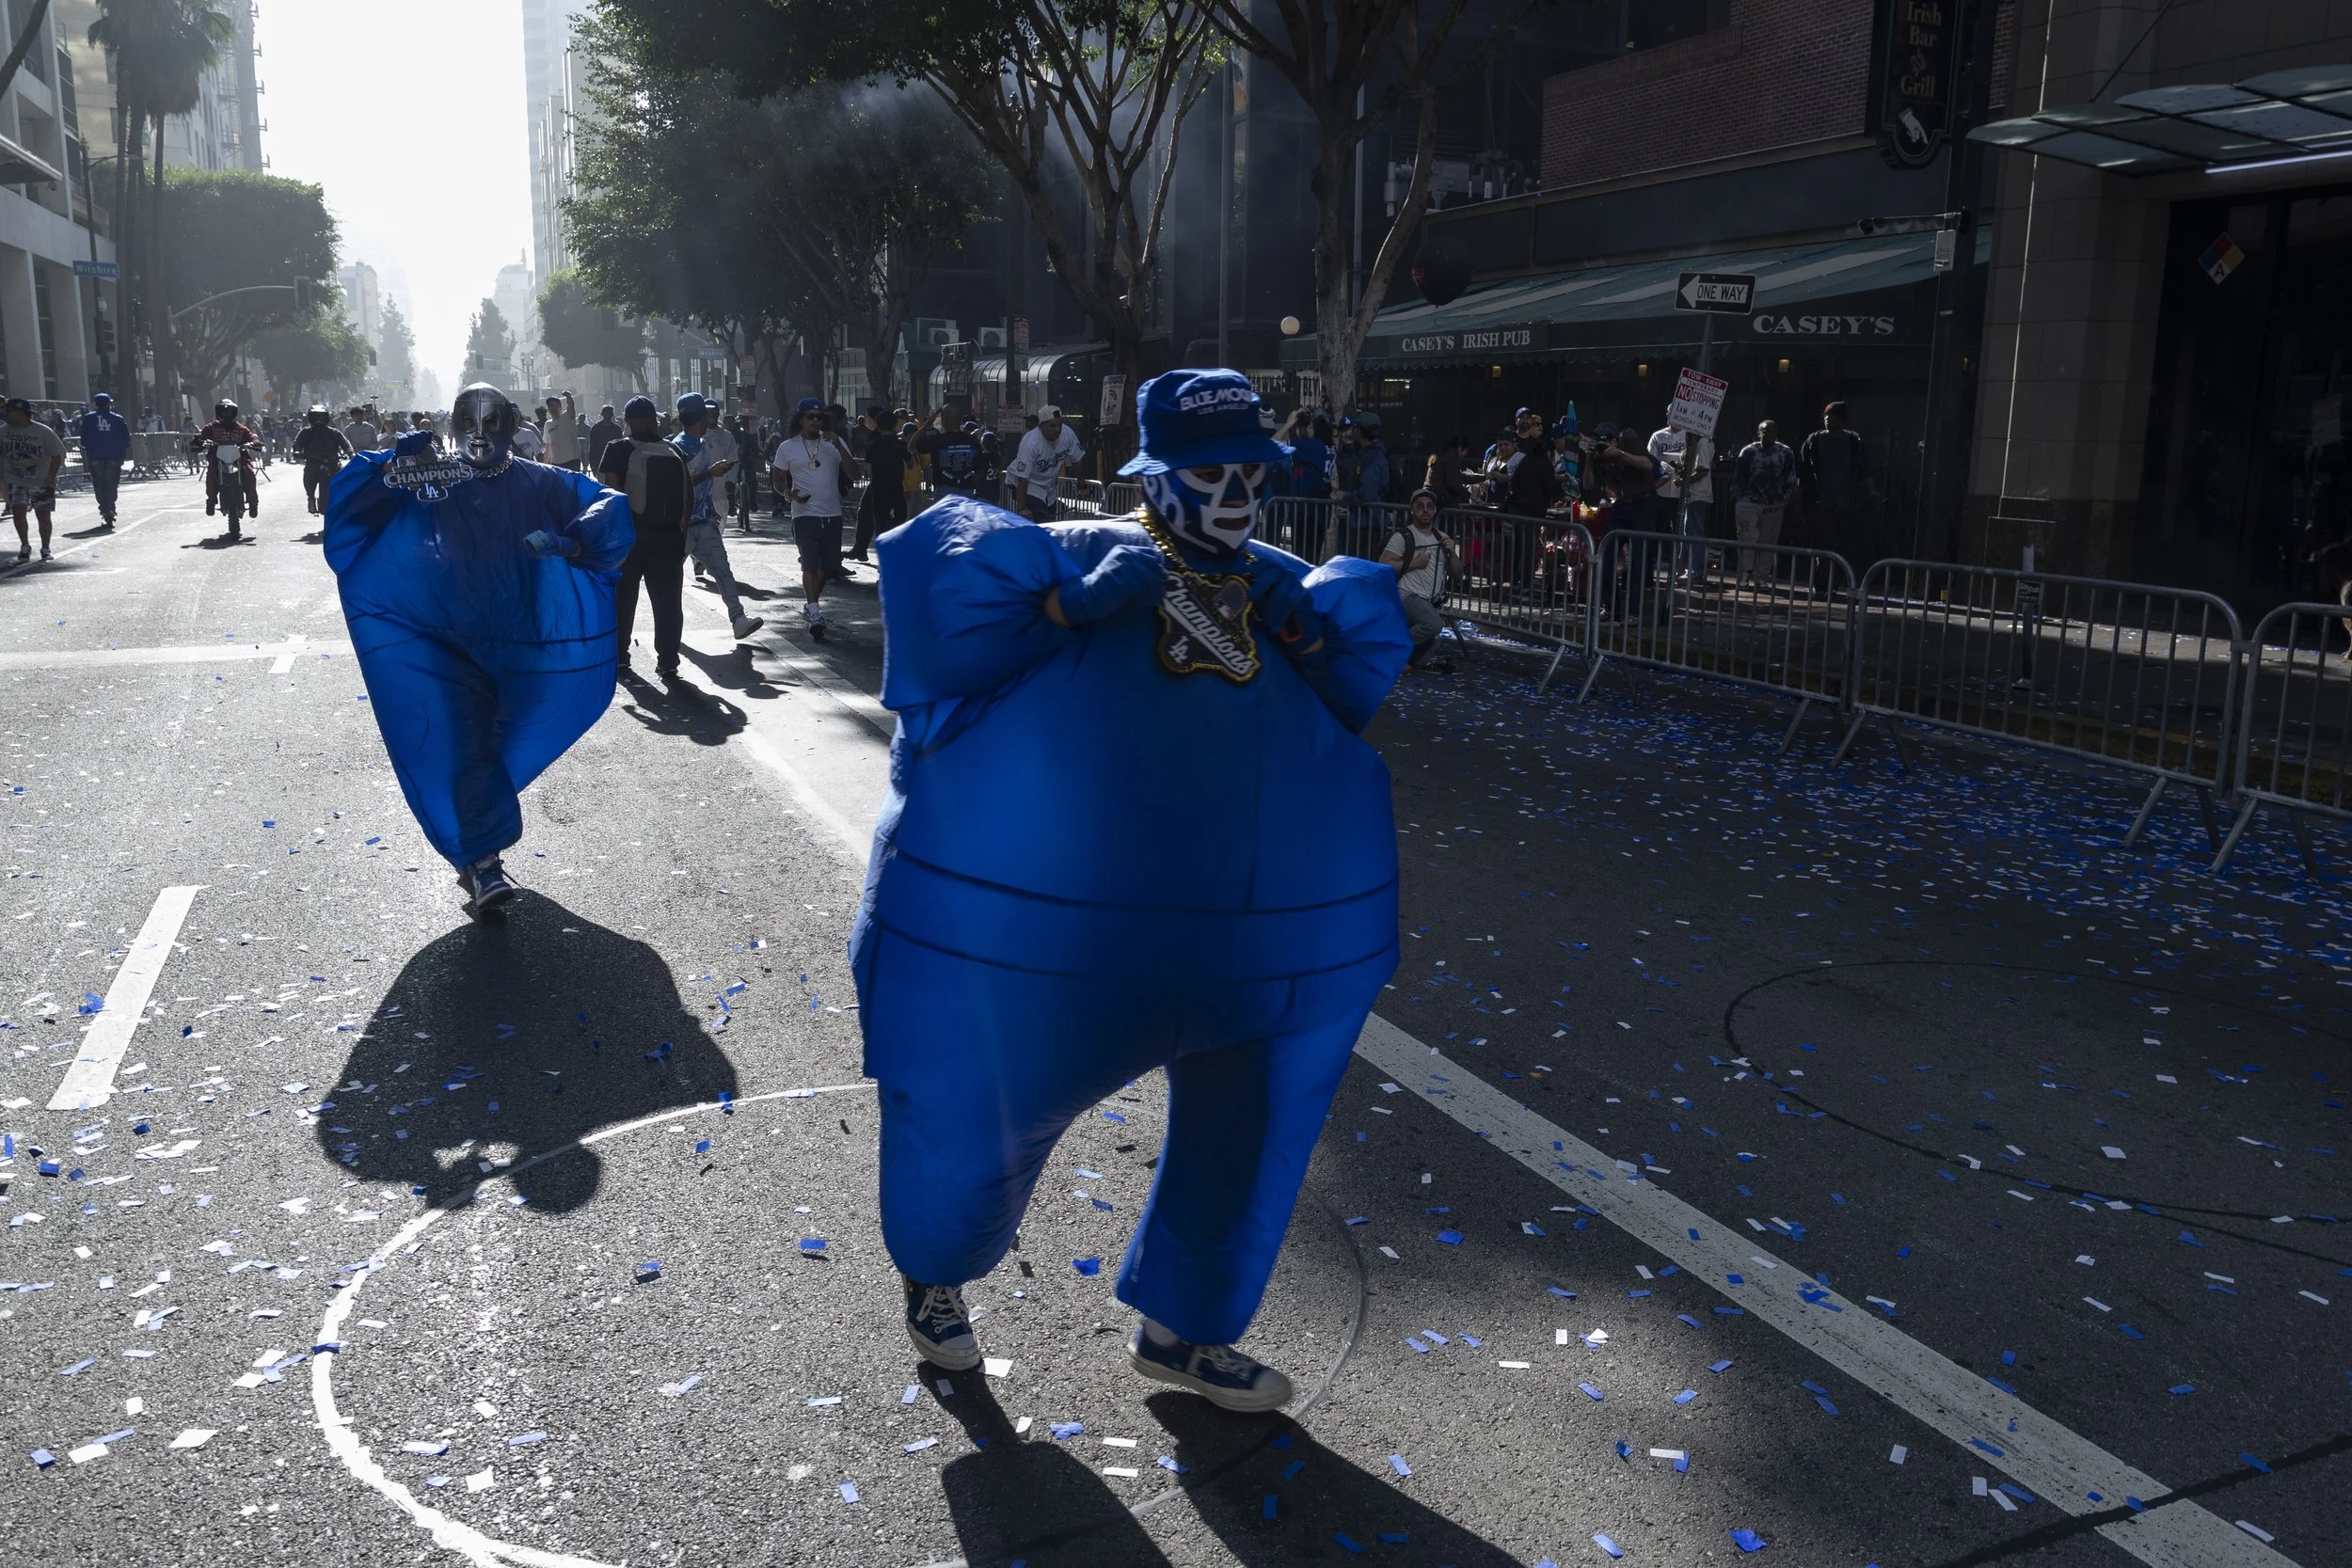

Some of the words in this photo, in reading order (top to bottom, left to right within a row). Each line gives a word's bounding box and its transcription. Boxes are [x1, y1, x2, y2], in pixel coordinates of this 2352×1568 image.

[1906, 0, 1942, 26] Irish
[1908, 24, 1938, 47] Bar
[1900, 74, 1935, 98] Grill
[76, 263, 117, 275] Wilshire
[1696, 284, 1717, 299] ONE
[1721, 286, 1744, 301] WAY
[1753, 314, 1895, 335] CASEY'S
[1402, 335, 1454, 352] CASEY'S
[1462, 332, 1499, 349] IRISH
[1502, 330, 1531, 347] PUB
[1687, 379, 1719, 394] TEMPORARY
[1677, 384, 1692, 401] NO
[1691, 390, 1721, 410] STOPPING
[98, 416, 111, 431] LA
[1674, 414, 1695, 427] MONDAY
[1696, 421, 1711, 431] ONLY
[386, 467, 471, 485] CHAMPIONS
[395, 464, 426, 473] WORLD
[424, 483, 438, 499] LA
[1165, 575, 1254, 674] Champions
[1168, 636, 1189, 663] LA
